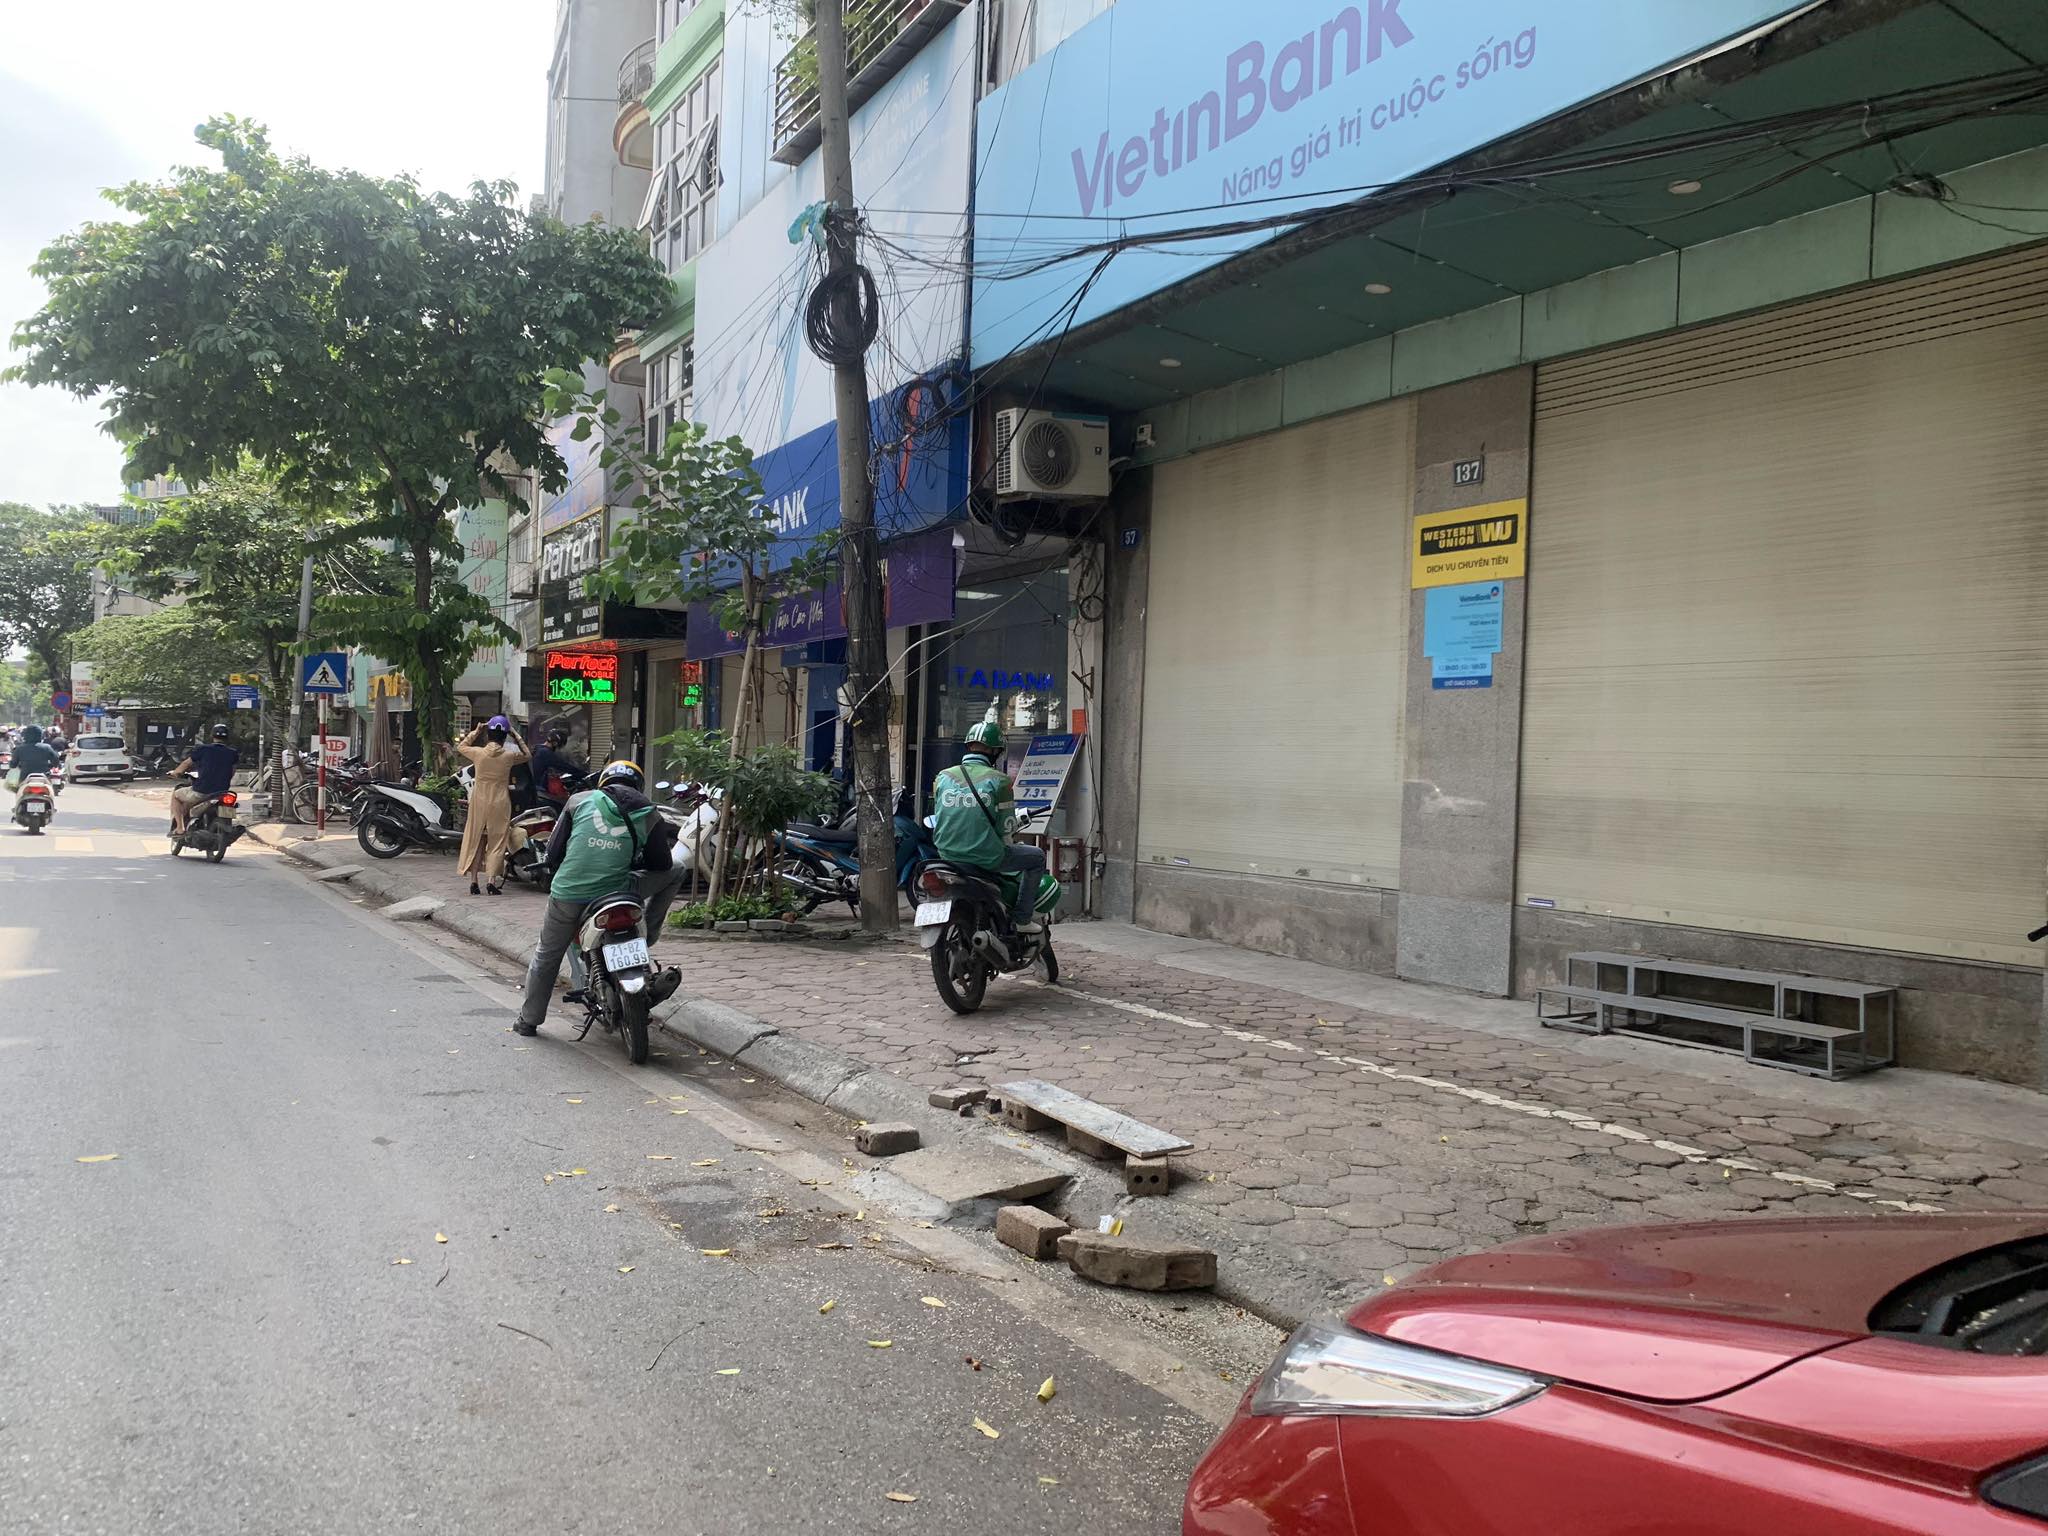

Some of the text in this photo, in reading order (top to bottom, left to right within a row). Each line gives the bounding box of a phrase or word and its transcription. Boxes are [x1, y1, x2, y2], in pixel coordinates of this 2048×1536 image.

[1071, 0, 1414, 217] VietinBank
[1221, 25, 1537, 205] Nâng giá trị cuộc sống
[1455, 461, 1480, 484] 137
[1423, 525, 1475, 542] WESTERN
[1480, 520, 1512, 543] WU
[1438, 535, 1475, 549] UNION
[549, 654, 617, 671] Perfect
[582, 670, 615, 679] MOBILE
[549, 678, 583, 701] 131
[326, 741, 342, 750] 115
[941, 788, 992, 808] Grab
[587, 836, 622, 851] gojek
